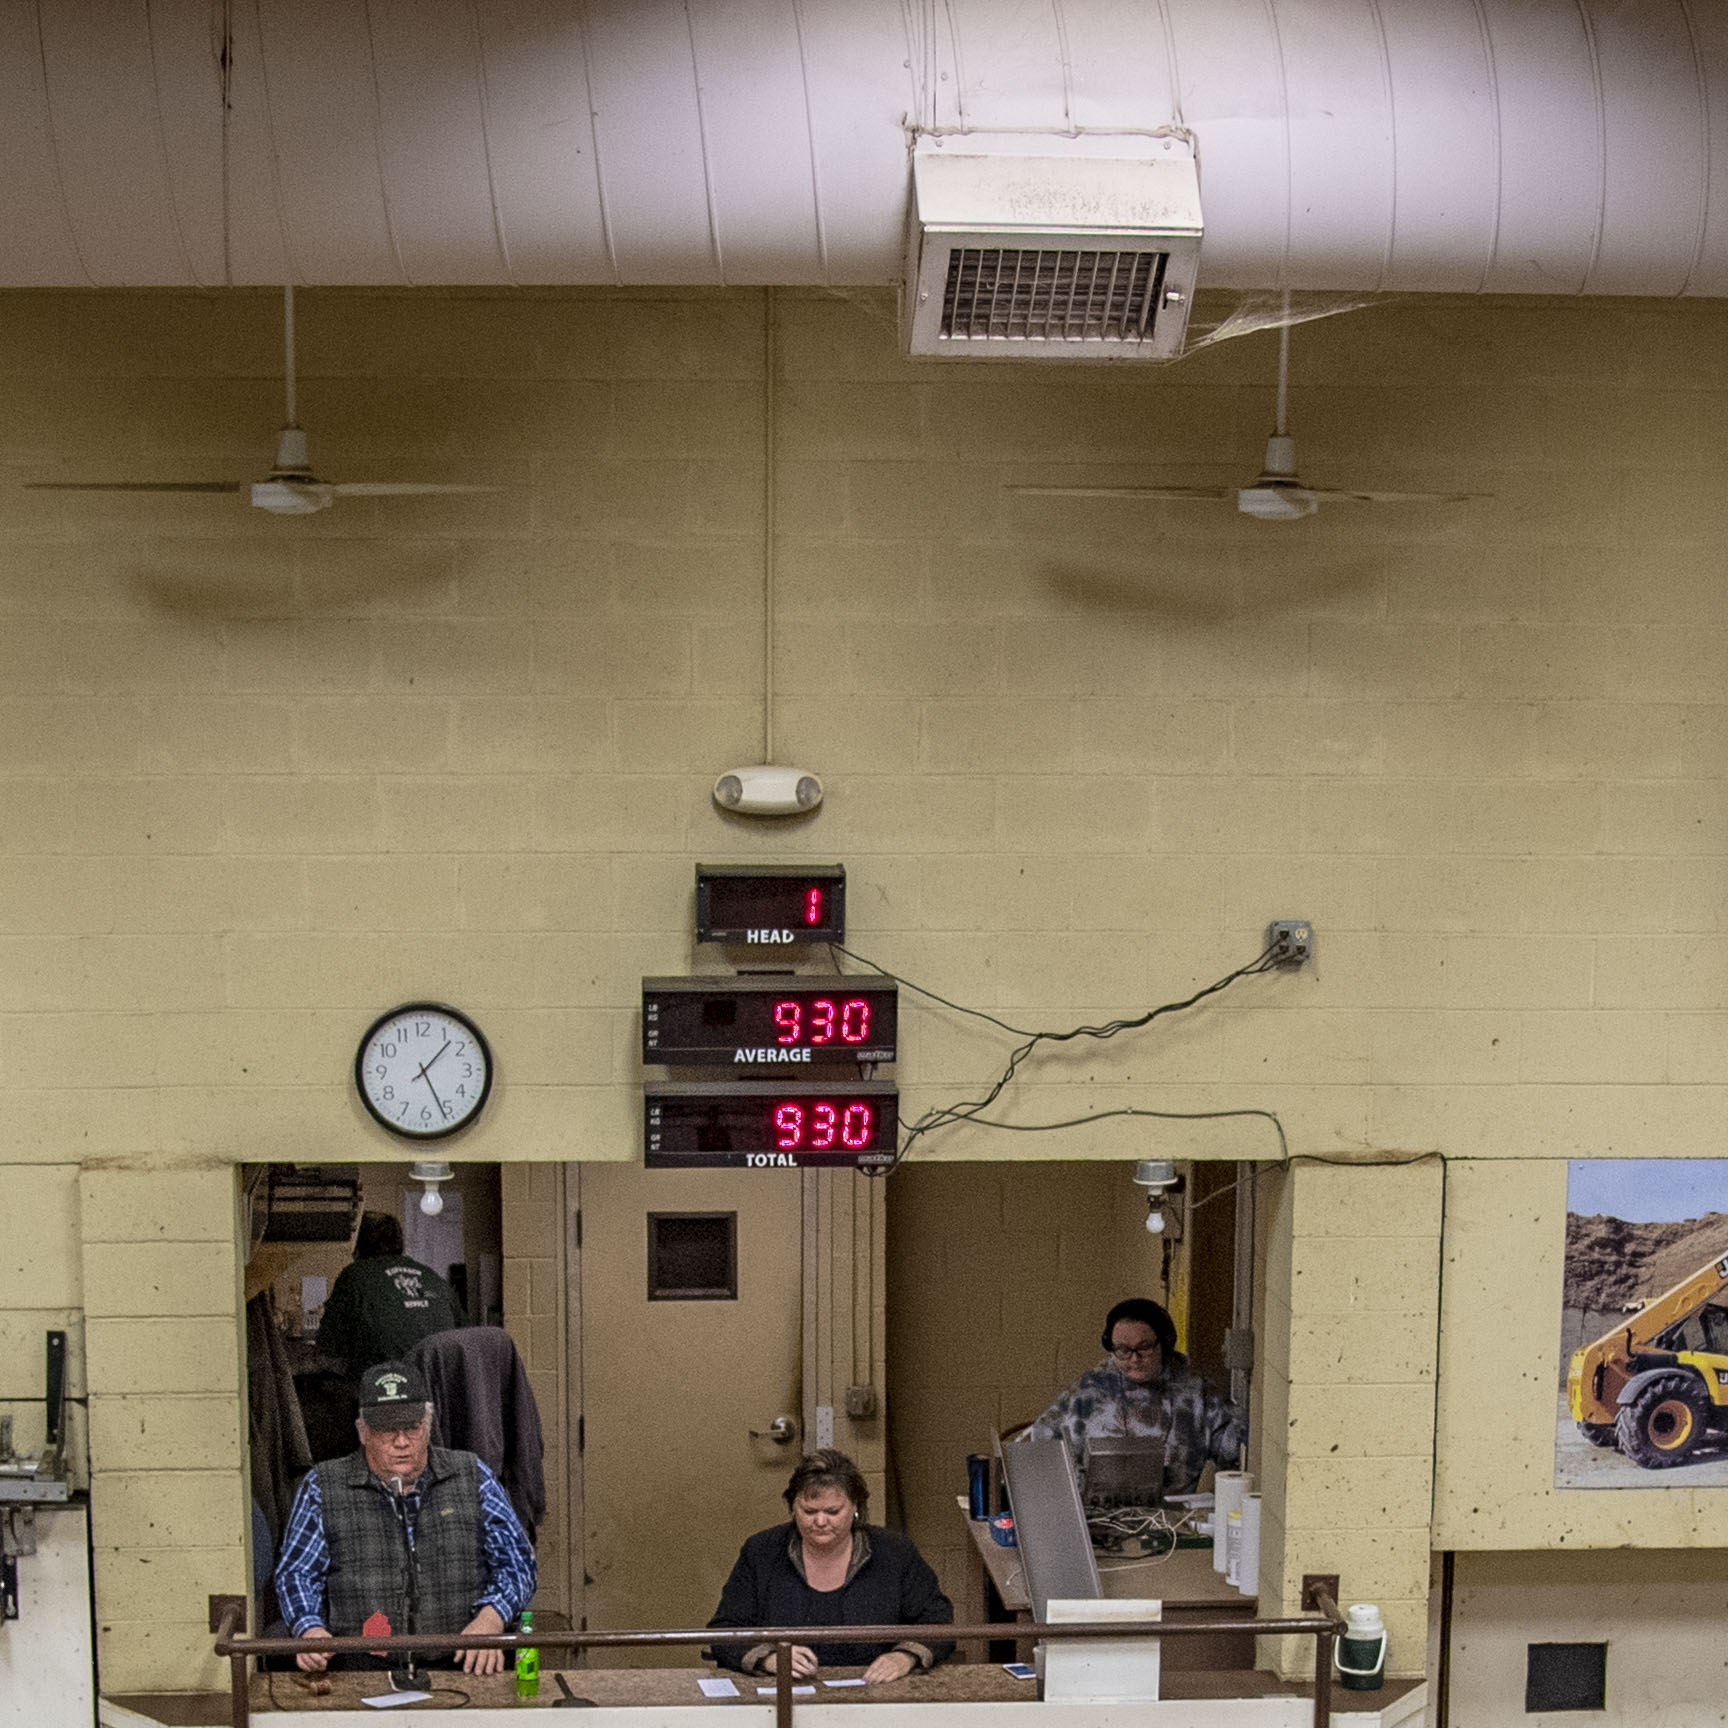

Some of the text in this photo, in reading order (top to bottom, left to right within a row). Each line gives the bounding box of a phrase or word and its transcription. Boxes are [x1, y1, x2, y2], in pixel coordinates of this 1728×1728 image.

[807, 888, 821, 924] 1
[746, 929, 794, 944] HEAD
[415, 1021, 431, 1037] 12
[775, 1001, 871, 1043] 930
[397, 1028, 408, 1042] 11
[441, 1027, 446, 1041] 1
[380, 1042, 397, 1058] 10
[455, 1041, 465, 1057] 2
[734, 1049, 811, 1062] AVERAGE
[375, 1064, 387, 1080] 9
[462, 1062, 472, 1078] 3
[382, 1085, 394, 1101] 8
[455, 1083, 466, 1098] 4
[399, 1101, 409, 1116] 7
[420, 1105, 432, 1120] 6
[442, 1100, 453, 1115] 5
[776, 1105, 871, 1147] 930
[746, 1154, 797, 1167] TOTAL
